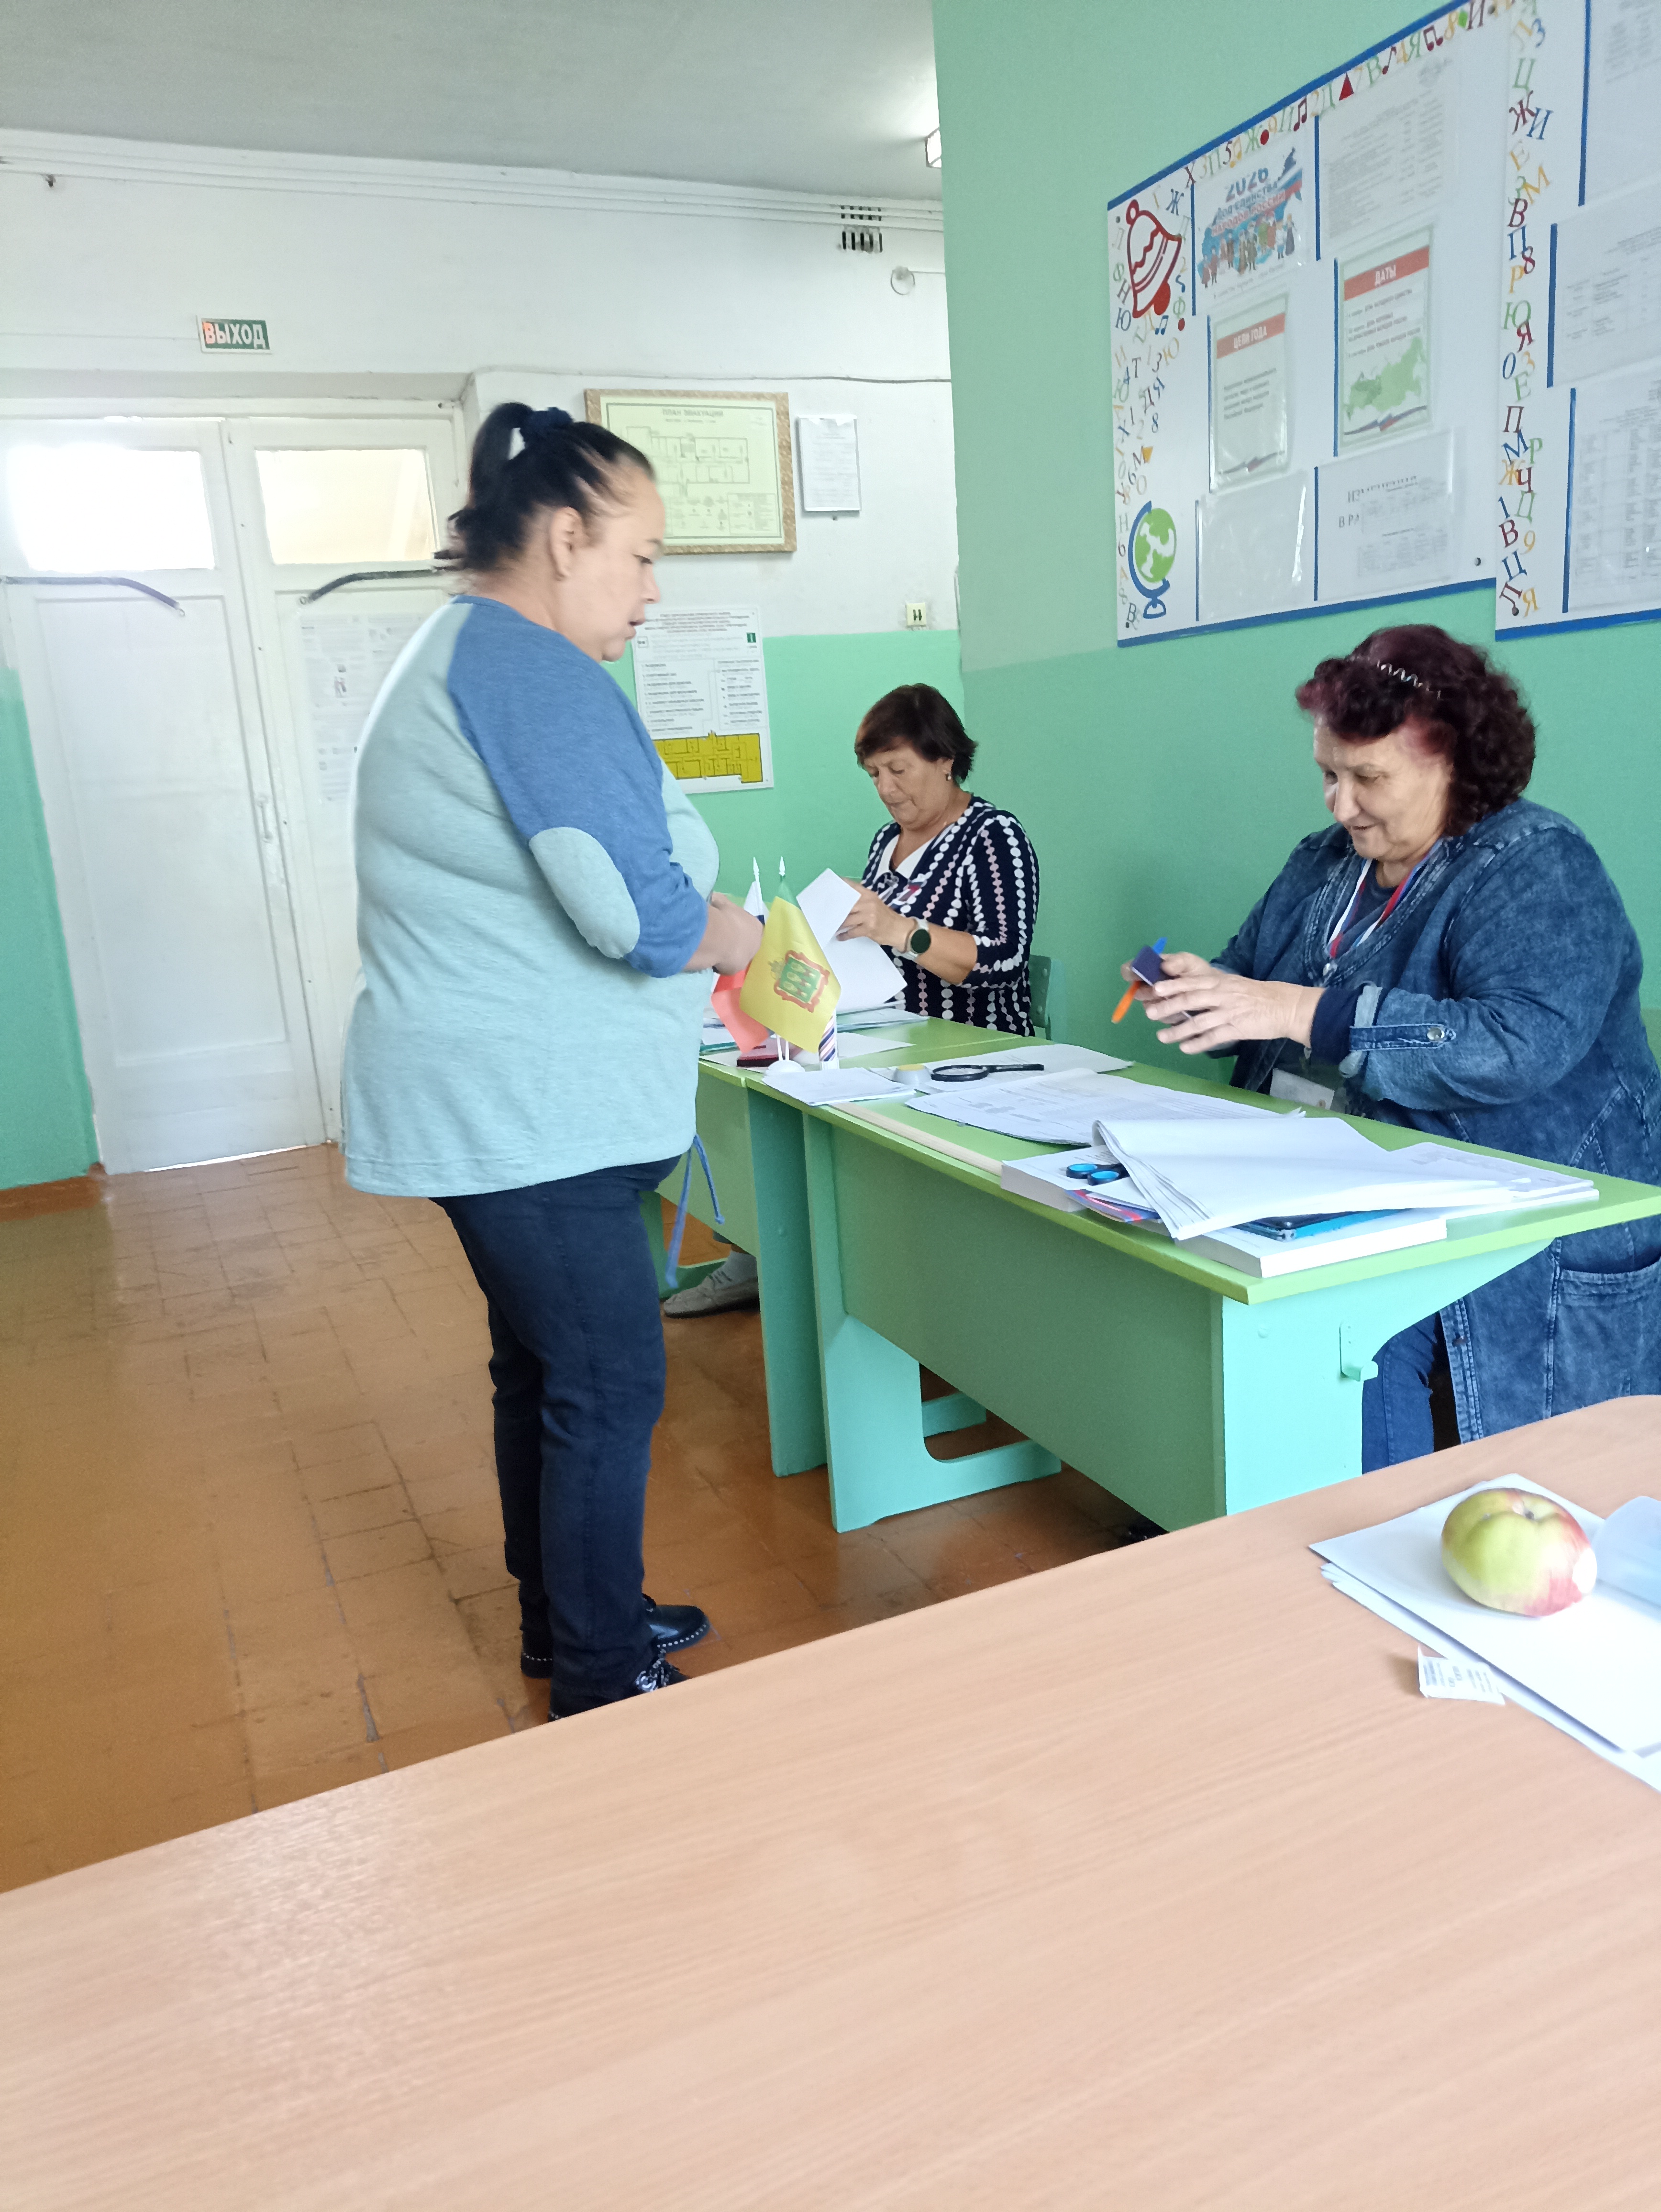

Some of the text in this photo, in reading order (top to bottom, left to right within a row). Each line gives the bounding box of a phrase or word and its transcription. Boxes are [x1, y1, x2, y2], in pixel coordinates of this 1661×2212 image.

[1526, 106, 1554, 140] И
[1506, 198, 1528, 228] В
[1521, 245, 1536, 275] 8
[1374, 264, 1396, 287] ДАТЫ
[1508, 264, 1525, 294] Р
[1115, 307, 1132, 332] Ю
[1173, 296, 1186, 319] Ф
[1502, 300, 1532, 330] Ю
[202, 321, 266, 349] ВЫХОД
[1517, 320, 1535, 353] Я
[1131, 357, 1142, 378] Т
[1151, 412, 1159, 433] 8
[1501, 427, 1529, 465] М
[1528, 437, 1543, 465] Р
[1516, 467, 1533, 494] Ч
[1498, 519, 1518, 549] В
[1520, 530, 1536, 555] 9
[1127, 602, 1137, 623] В
[1522, 587, 1539, 618] Я
